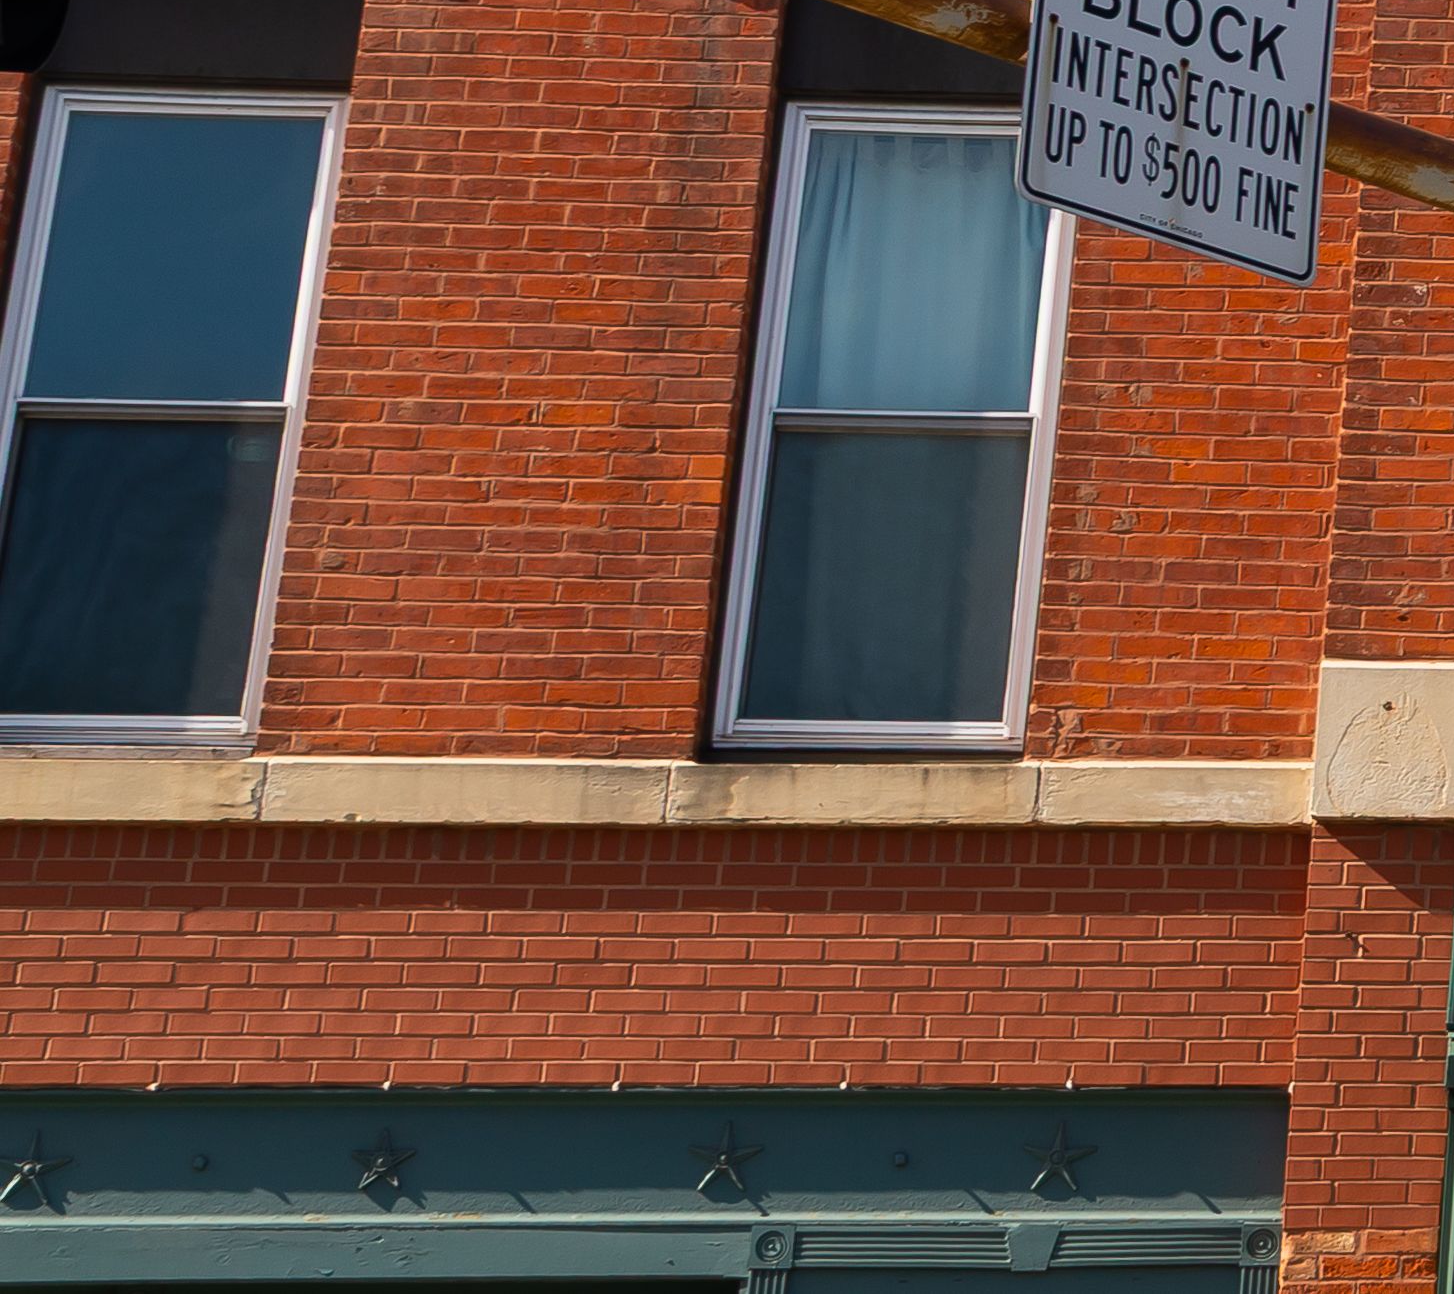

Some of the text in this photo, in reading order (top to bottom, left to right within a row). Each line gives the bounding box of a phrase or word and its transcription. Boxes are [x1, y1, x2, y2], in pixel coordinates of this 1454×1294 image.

[1052, 26, 1305, 166] INTERSECTION
[1045, 103, 1299, 240] UP TO $500 FINE
